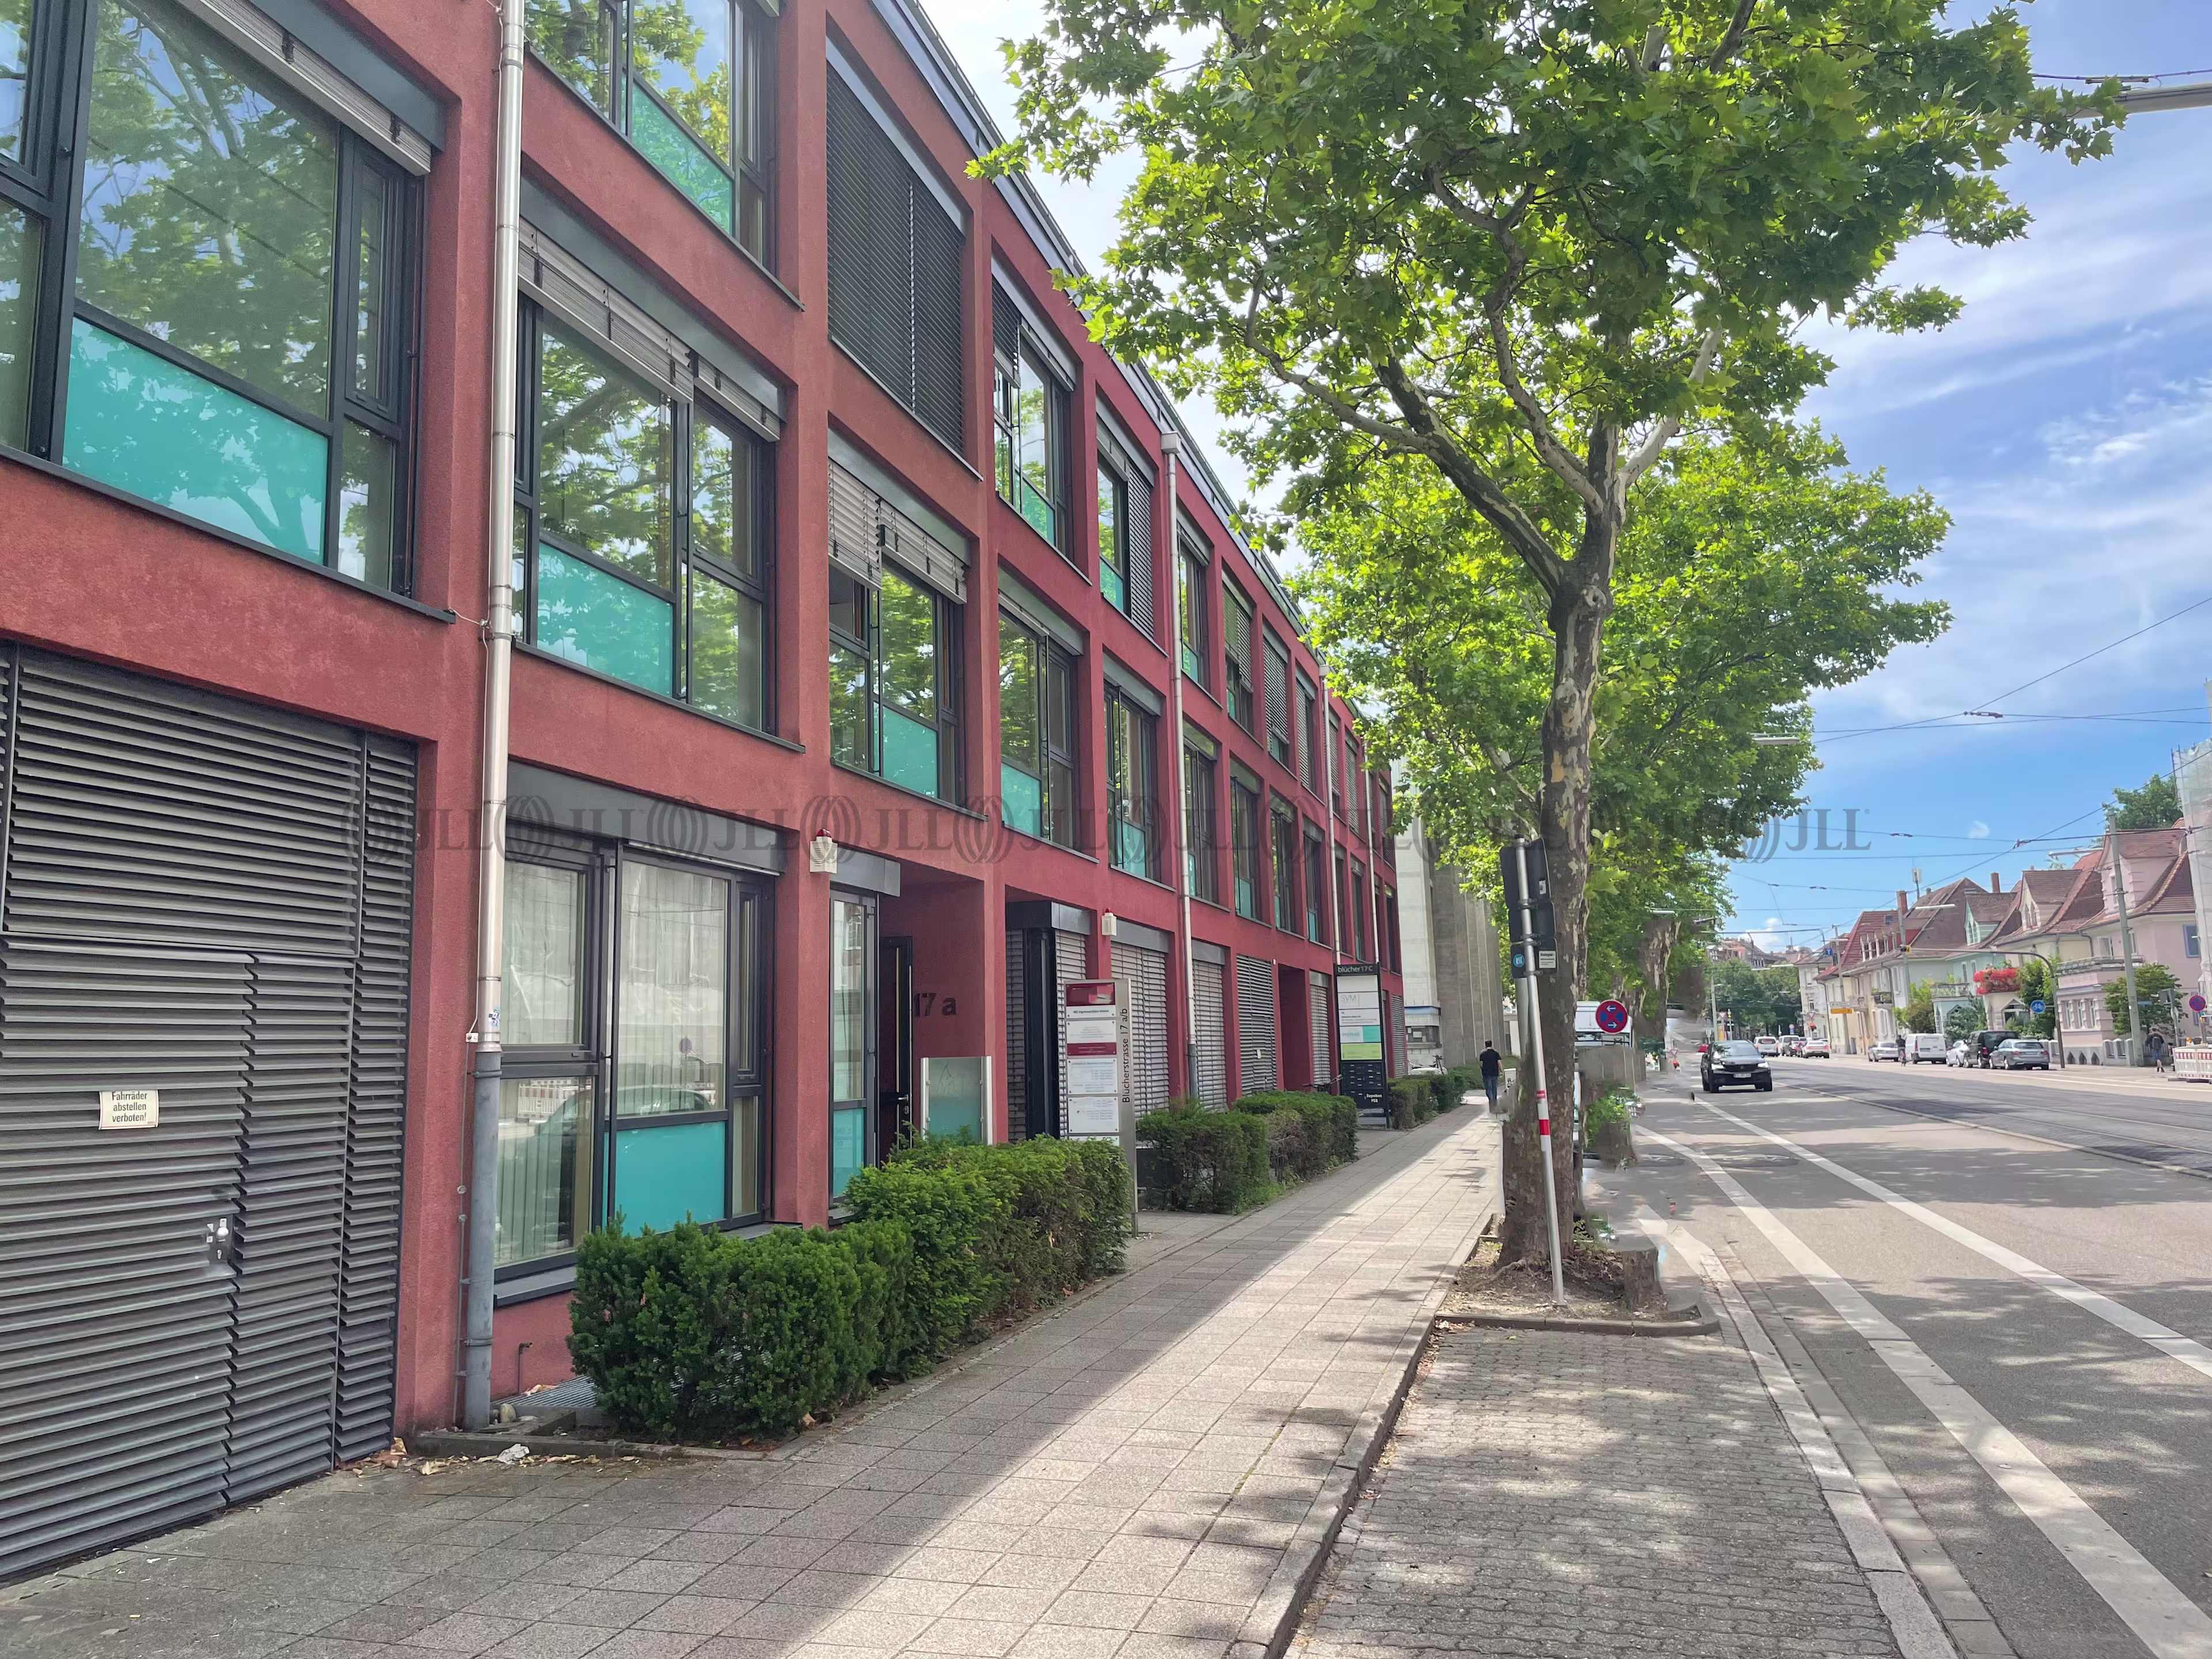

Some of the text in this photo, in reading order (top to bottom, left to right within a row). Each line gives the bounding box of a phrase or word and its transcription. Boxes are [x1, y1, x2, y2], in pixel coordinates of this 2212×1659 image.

[1340, 994, 1356, 1002] SVM
[914, 993, 957, 1017] 17 a
[1120, 1008, 1128, 1022] a/b
[112, 1091, 147, 1101] Fahrräder
[113, 1101, 147, 1112] abstellen
[112, 1112, 146, 1122] verboten!
